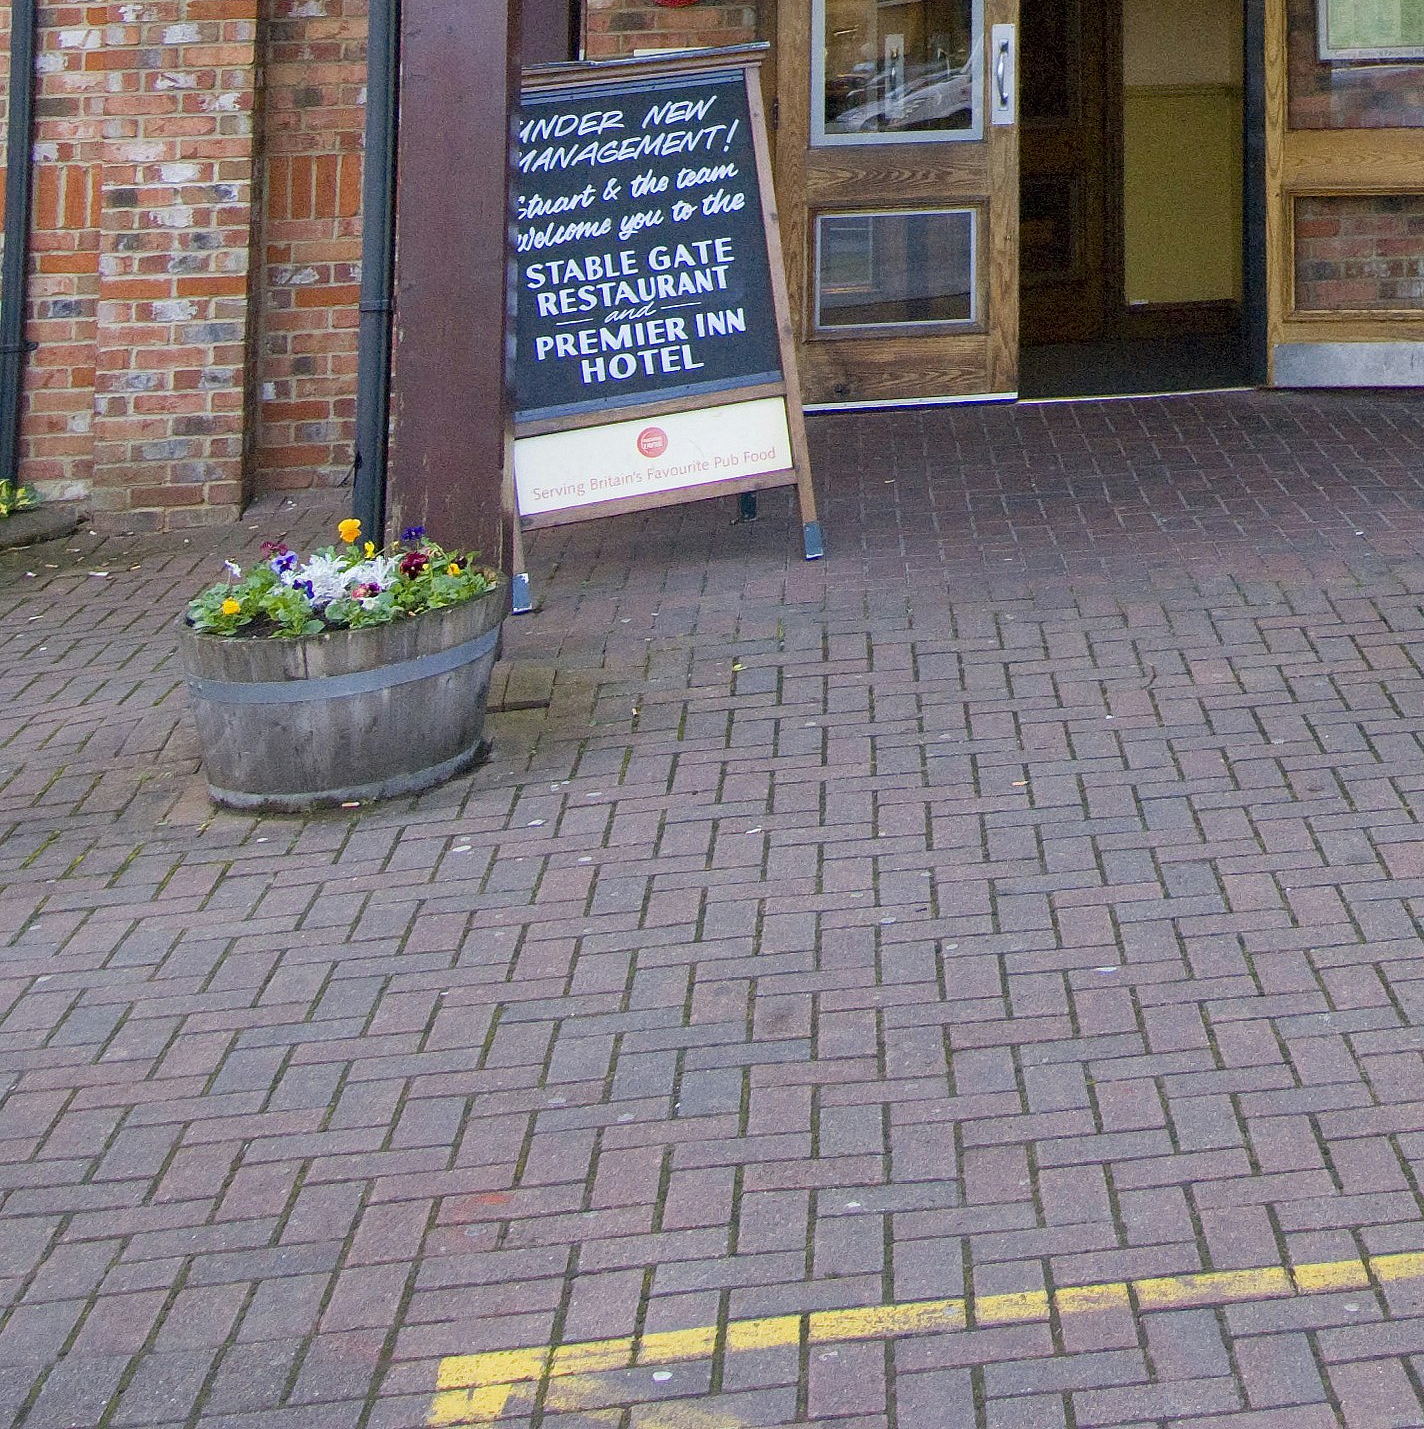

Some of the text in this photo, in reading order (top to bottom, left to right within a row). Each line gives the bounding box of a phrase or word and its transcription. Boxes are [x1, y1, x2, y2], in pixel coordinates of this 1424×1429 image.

[642, 95, 717, 129] NEW
[518, 163, 739, 220] Stuart & the team
[517, 189, 746, 253] Welcome you to the
[526, 237, 735, 289] STABLE GATE
[537, 265, 729, 317] RESTAURANT
[604, 301, 657, 324] and
[536, 308, 746, 361] PREMIER INN
[581, 344, 704, 384] HOTEL
[533, 446, 777, 501] Serving Britain's Favourite Pub Food
